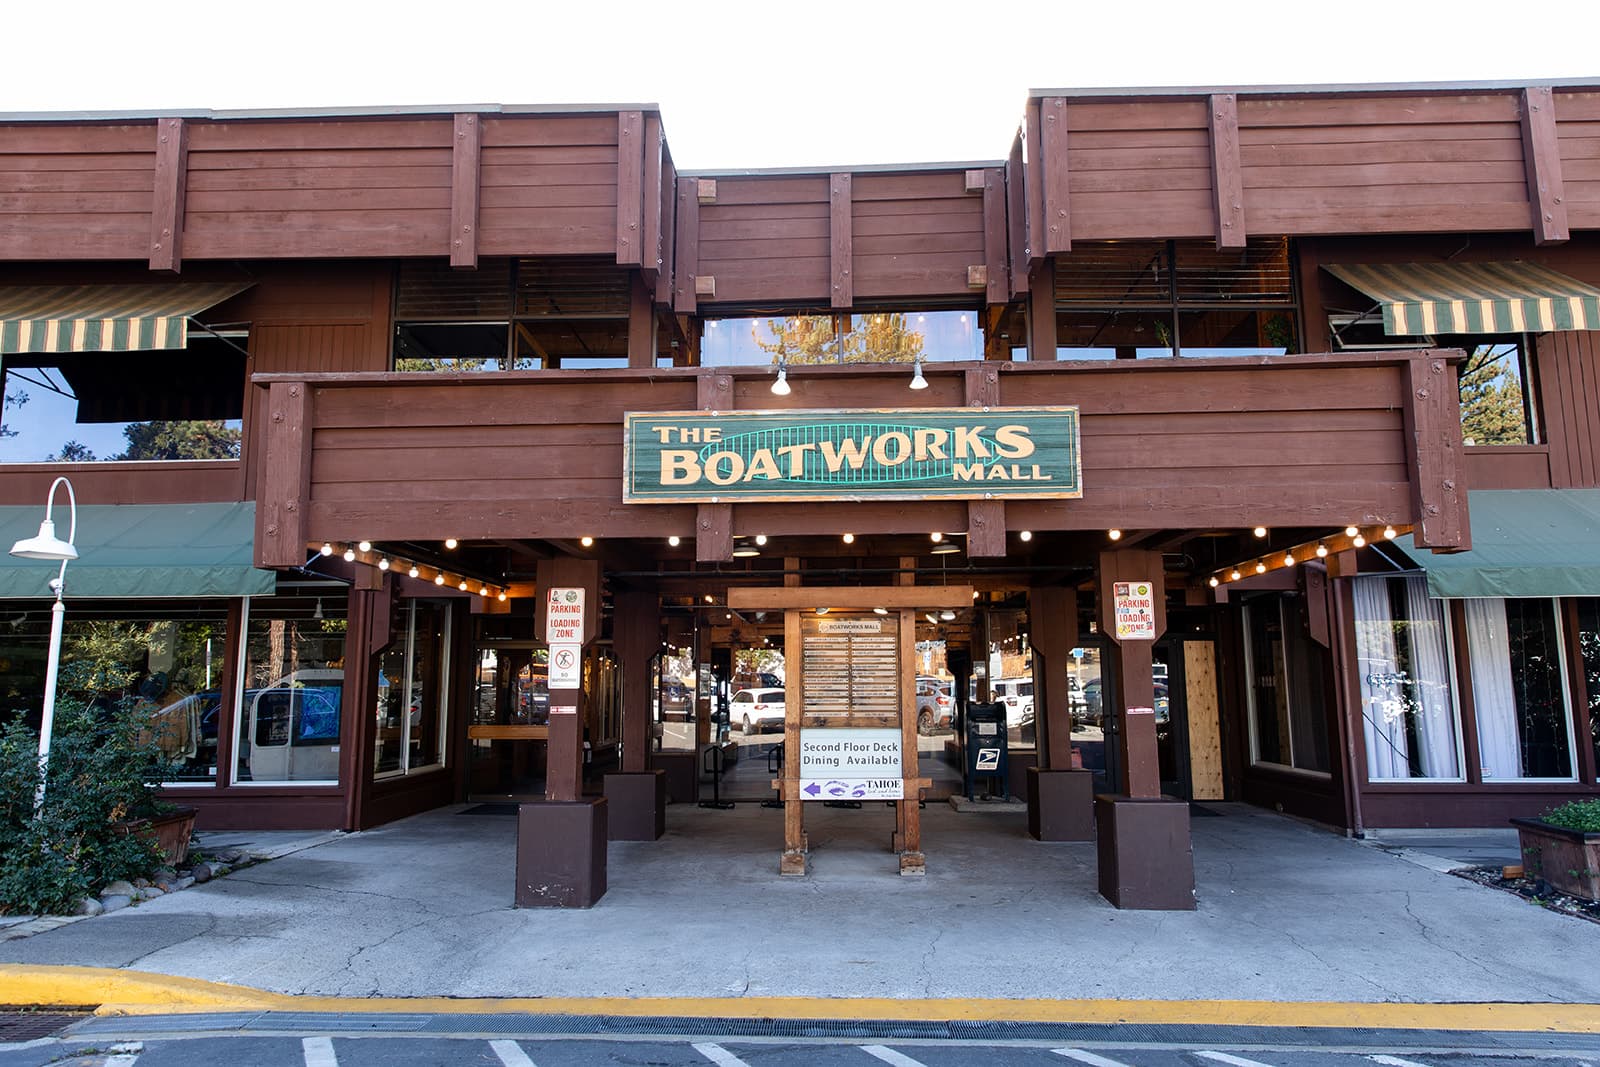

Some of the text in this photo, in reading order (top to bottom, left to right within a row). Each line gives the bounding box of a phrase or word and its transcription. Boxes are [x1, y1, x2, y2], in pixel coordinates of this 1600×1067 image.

[652, 426, 722, 443] THE
[659, 424, 1036, 486] BOATWORKS
[952, 463, 1052, 481] MALL
[1118, 600, 1150, 608] PARKING
[551, 605, 581, 614] PARKING
[1119, 614, 1151, 623] LOADING
[550, 619, 580, 628] LOADING
[556, 629, 575, 638] ZONE
[803, 742, 898, 752] Second Floor Deck
[803, 756, 899, 767] Dining Available
[866, 780, 901, 789] TAHOE
